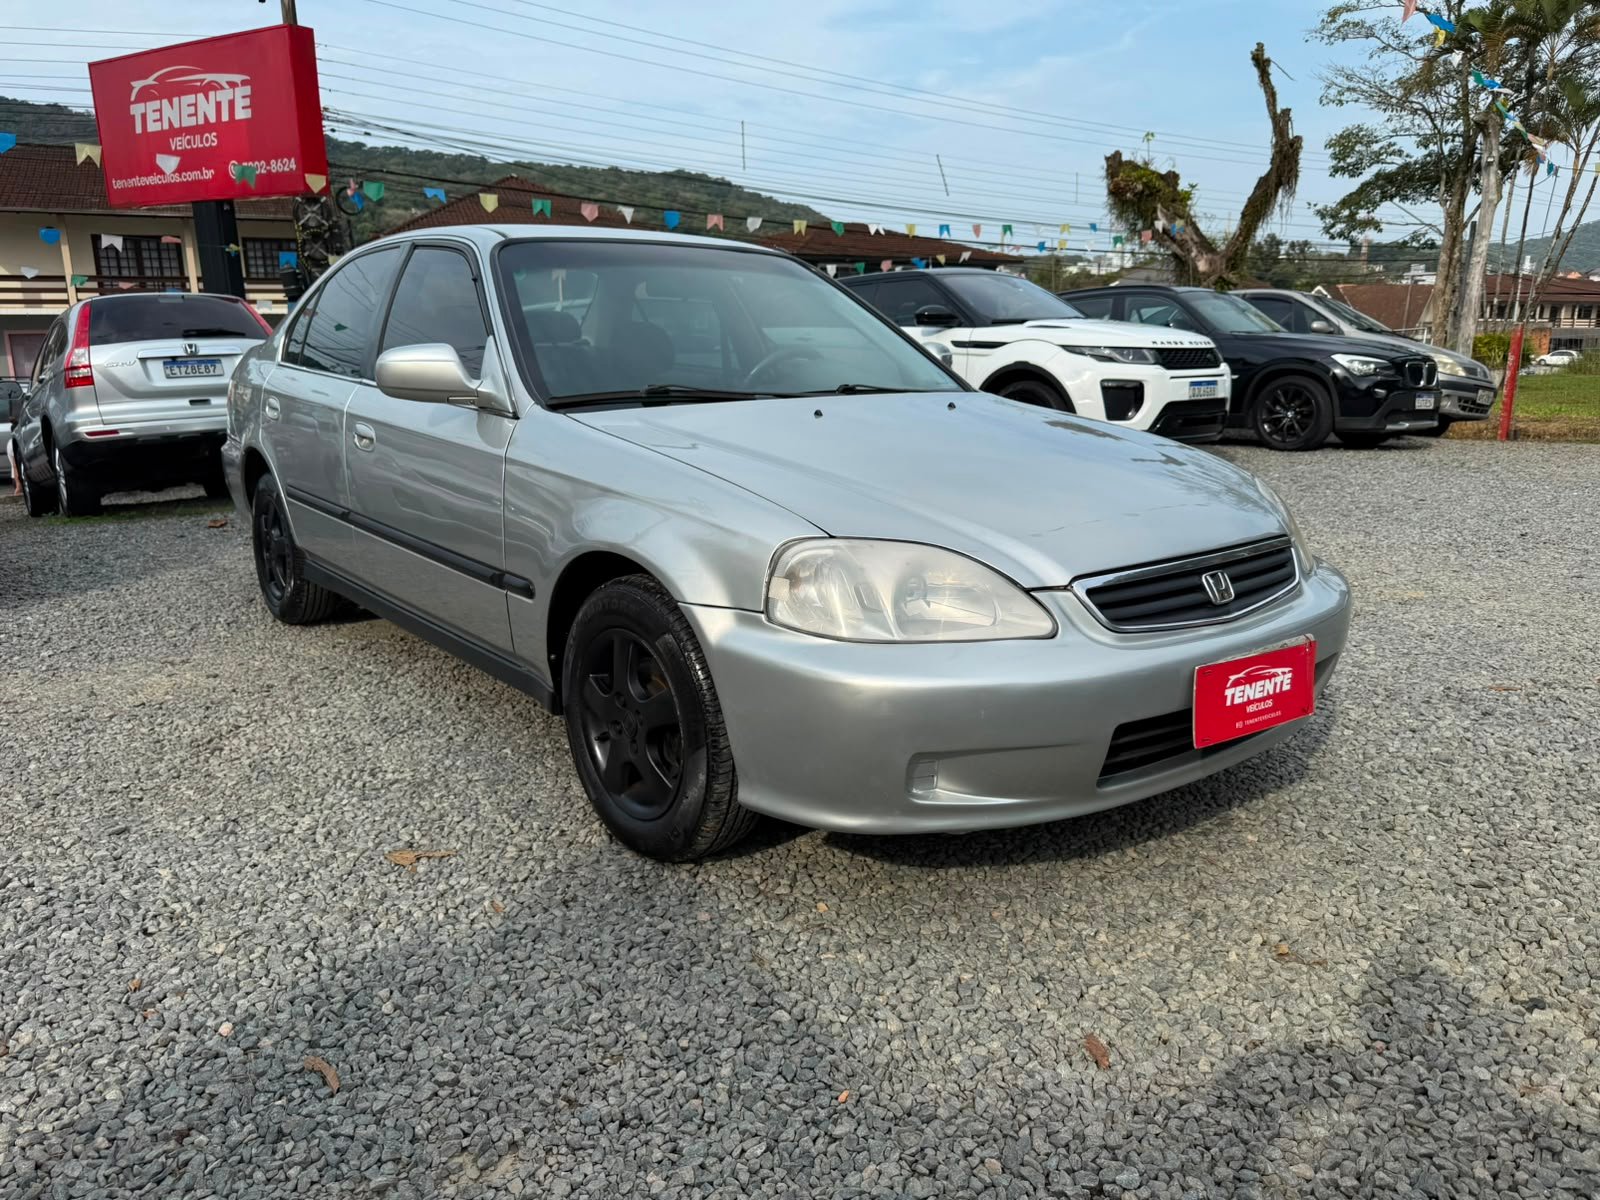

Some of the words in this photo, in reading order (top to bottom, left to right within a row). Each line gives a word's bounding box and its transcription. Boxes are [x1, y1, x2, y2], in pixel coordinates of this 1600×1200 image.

[130, 86, 251, 134] TENENTE
[169, 133, 217, 150] VEÍCULOS
[112, 167, 214, 189] tenenteveiculos.com.br
[1225, 673, 1292, 706] TENENTE
